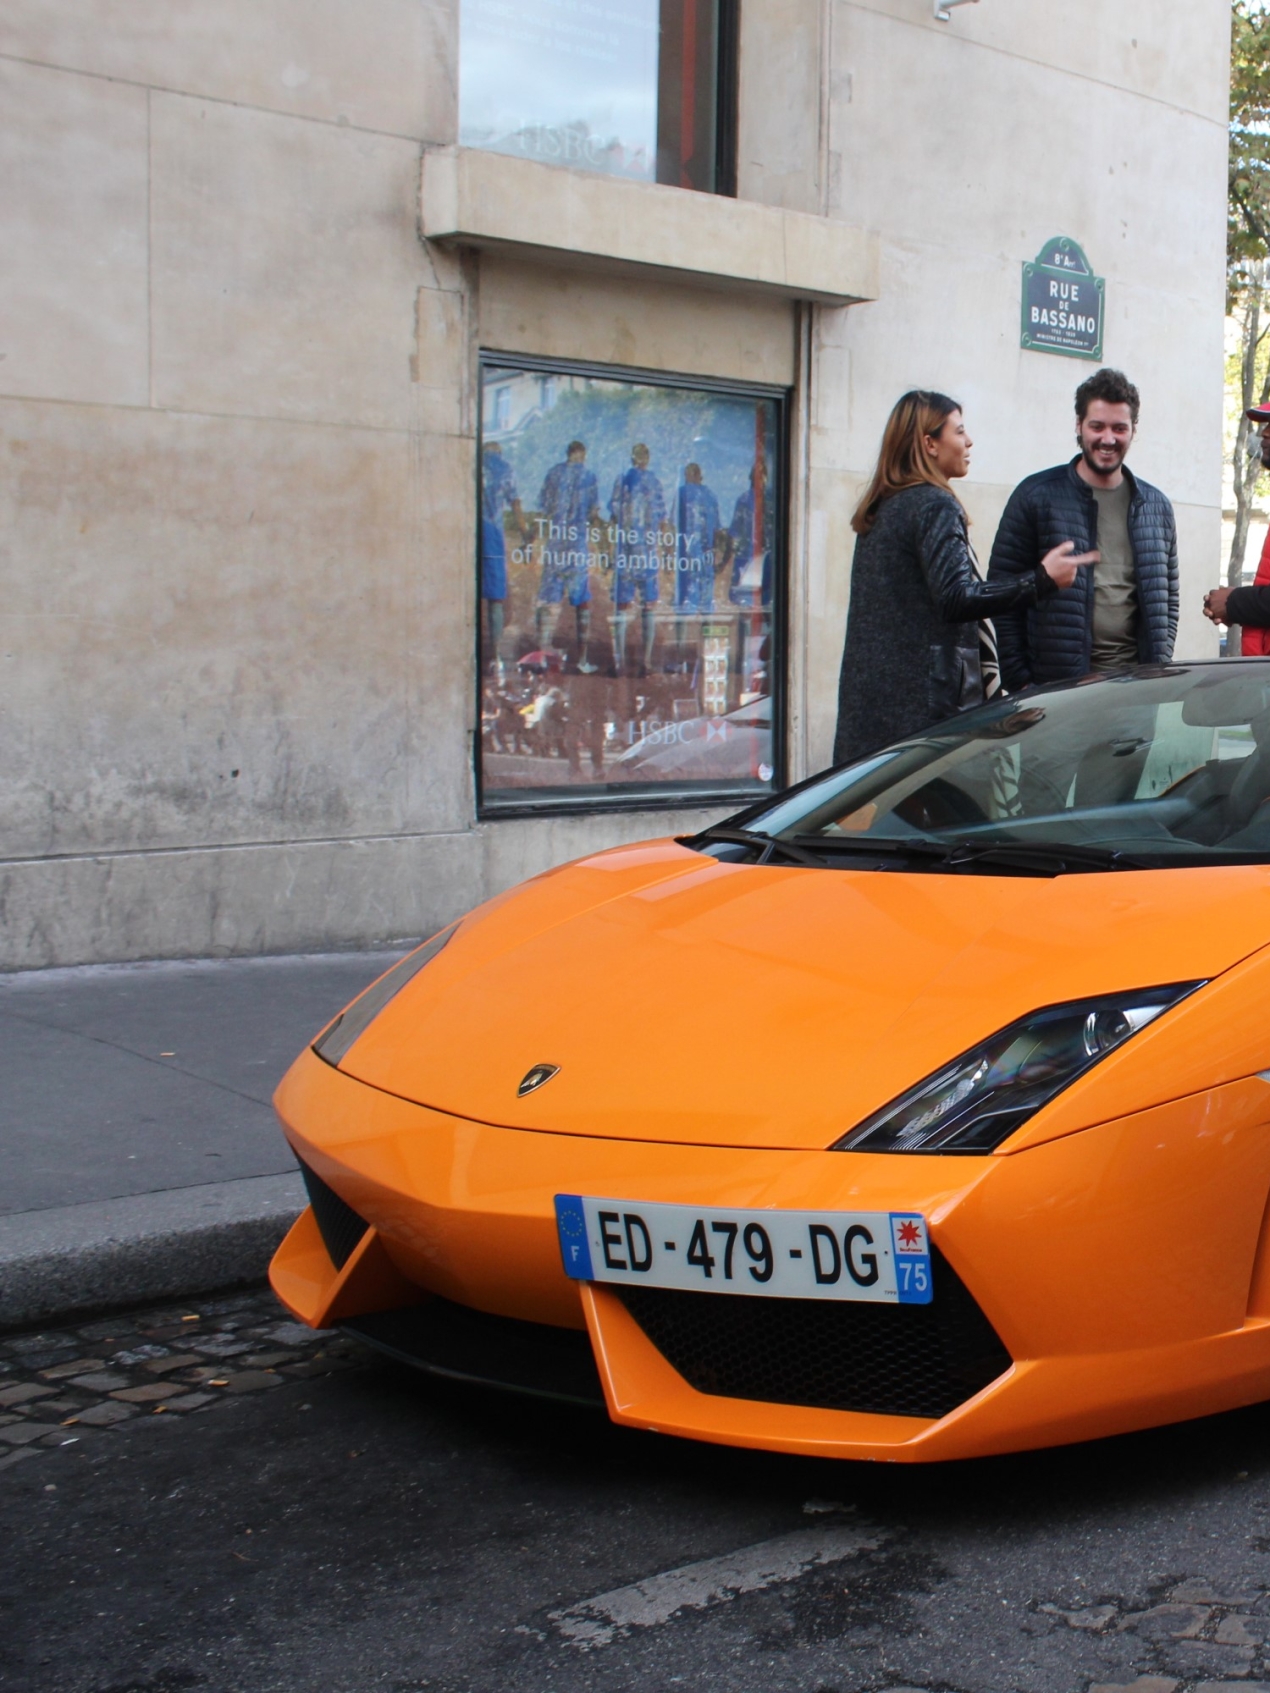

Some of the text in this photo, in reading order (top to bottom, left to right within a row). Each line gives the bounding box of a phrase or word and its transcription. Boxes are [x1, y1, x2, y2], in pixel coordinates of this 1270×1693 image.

[519, 118, 604, 166] HSBC
[1049, 280, 1079, 301] RUE
[1059, 301, 1069, 311] DE
[1031, 306, 1095, 333] BASSANO
[534, 518, 695, 552] This is the story
[511, 544, 533, 564] of
[540, 545, 610, 568] human
[628, 720, 695, 745] HSBC
[570, 1246, 580, 1262] F
[899, 1263, 928, 1292] 75
